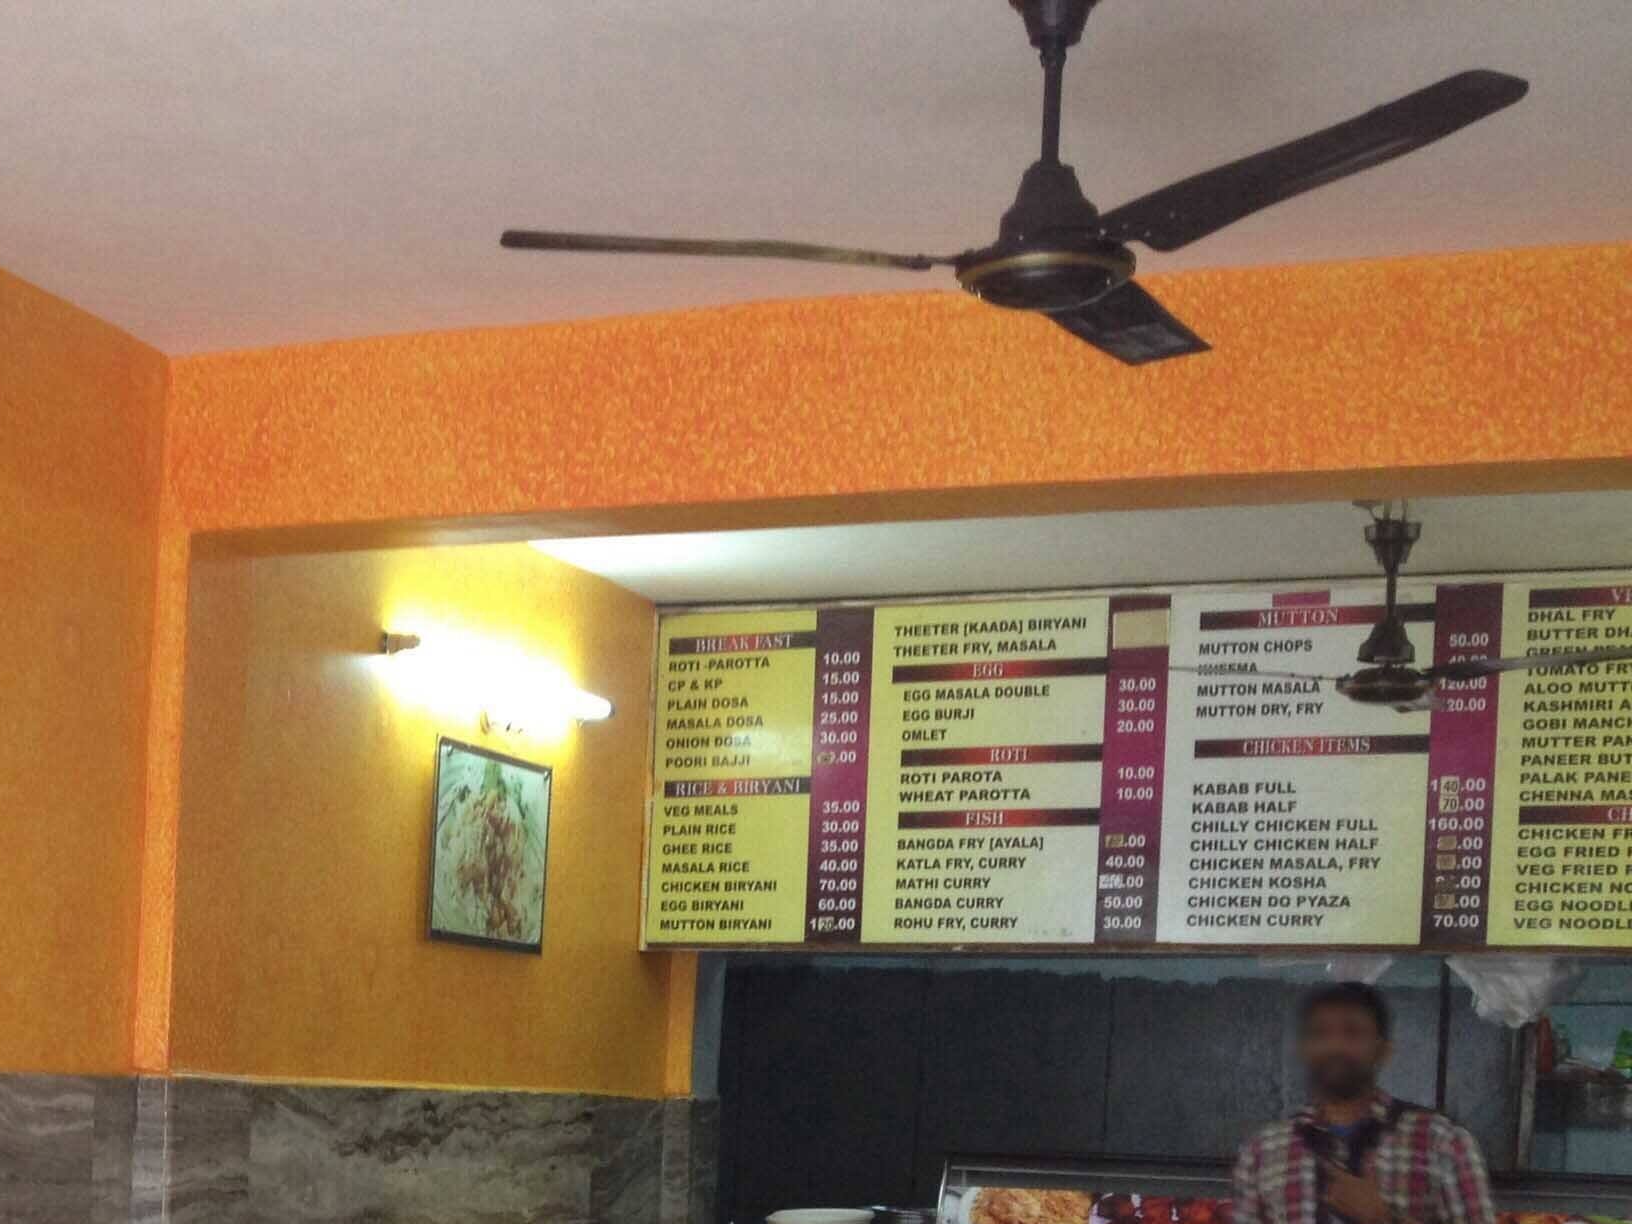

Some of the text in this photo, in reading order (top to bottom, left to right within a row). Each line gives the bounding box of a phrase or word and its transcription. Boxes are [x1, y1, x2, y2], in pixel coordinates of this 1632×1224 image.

[1258, 609, 1338, 626] MUTTON
[1528, 609, 1616, 623] DHAL FRY
[894, 624, 959, 637] THEETER
[1028, 618, 1087, 632] BIRYANI
[1449, 633, 1489, 647] 50.00
[1526, 628, 1599, 641] BUTTER
[893, 640, 1056, 657] THEETER FRY, MASALA
[1199, 640, 1313, 655] MUTTON CHOPS
[823, 651, 861, 665] 10.00
[669, 661, 700, 673] ROTI
[972, 664, 1004, 678] EGG
[690, 679, 700, 691] &
[704, 678, 723, 690] KP
[822, 671, 860, 685] 15.00
[1119, 678, 1156, 692] 30.00
[1197, 681, 1320, 698] MUTTON MASALA
[1524, 681, 1632, 695] ALOO MUTT
[822, 692, 859, 705] 15.00
[903, 685, 1050, 702] EGG MASALA DOUBLE
[667, 697, 749, 712] PLAIN DOSA
[1118, 700, 1155, 712] 30.00
[1196, 702, 1324, 718] MUTTON DRY, FRY
[1523, 700, 1613, 712] KASHMIRI
[820, 711, 858, 725] 25.00
[903, 708, 974, 722] EGG BURJI
[666, 715, 764, 731] MASALA DOSA
[1117, 720, 1154, 733] 20.00
[1523, 718, 1566, 730] GOBI
[665, 734, 752, 749] ONION DOSA
[820, 731, 857, 745] 30.00
[902, 730, 947, 742] OMLET
[1521, 736, 1596, 749] MUTTER
[1243, 736, 1370, 755] CHICKEN ITEMS
[665, 755, 707, 769] POORI
[990, 748, 1029, 763] ROTI
[1521, 755, 1591, 766] PANEER
[900, 771, 1002, 784] ROTI PAROTA
[1118, 767, 1154, 780] 10.00
[1520, 772, 1577, 784] PALAK
[676, 779, 800, 796] RICE & BIRYANI
[1117, 787, 1153, 800] 10.00
[1193, 782, 1296, 796] KABAB FULL
[900, 788, 1031, 803] WHEAT PAROTTA
[1519, 791, 1594, 802] CHENNA
[664, 804, 738, 817] VEG MEALS
[823, 801, 860, 813] 35.00
[1192, 801, 1297, 815] KABAB HALF
[965, 812, 1003, 826] FISH
[1429, 818, 1484, 832] 160.00
[663, 823, 736, 836] PLAIN RICE
[822, 821, 859, 833] 30.00
[1191, 819, 1378, 833] CHILLY CHICKEN FULL
[1518, 829, 1605, 840] CHICKEN
[663, 843, 732, 855] GHEE RICE
[821, 840, 858, 853] 35.00
[897, 838, 954, 850] BANGDA
[959, 837, 985, 849] FRY
[1190, 838, 1379, 852] CHILLY CHICKEN HALF
[1517, 847, 1556, 858] EGG
[1563, 846, 1620, 857] FRIED
[662, 861, 750, 874] MASALA RICE
[819, 860, 858, 872] 40.00
[897, 857, 1026, 871] KATLA FRY, CURRY
[1105, 855, 1145, 868] 40.00
[1189, 857, 1381, 872] CHICKEN MASALA, FRY
[1516, 865, 1555, 876] VEG
[1562, 864, 1618, 875] FRIED
[661, 880, 777, 893] CHICKEN BIRYANI
[819, 879, 857, 892] 70.00
[896, 877, 991, 890] MATHI CURRY
[1188, 877, 1327, 889] CHICKEN KOSHA
[1515, 882, 1602, 894] CHICKEN
[661, 900, 744, 912] EGG BIRYANI
[818, 899, 856, 911] 60.00
[895, 897, 1003, 910] BANGDA CURRY
[1104, 896, 1143, 909] 50.00
[1188, 895, 1351, 909] CHICKEN DO PYAZA
[1514, 900, 1554, 911] EGG
[660, 919, 772, 931] MUTTON BIRYANI
[894, 917, 1018, 930] ROHU FRY, CURRY
[1104, 916, 1142, 929] 30.00
[1187, 914, 1324, 928] CHICKEN CURRY
[1433, 914, 1479, 928] 70.00
[1514, 918, 1552, 929] VEG
